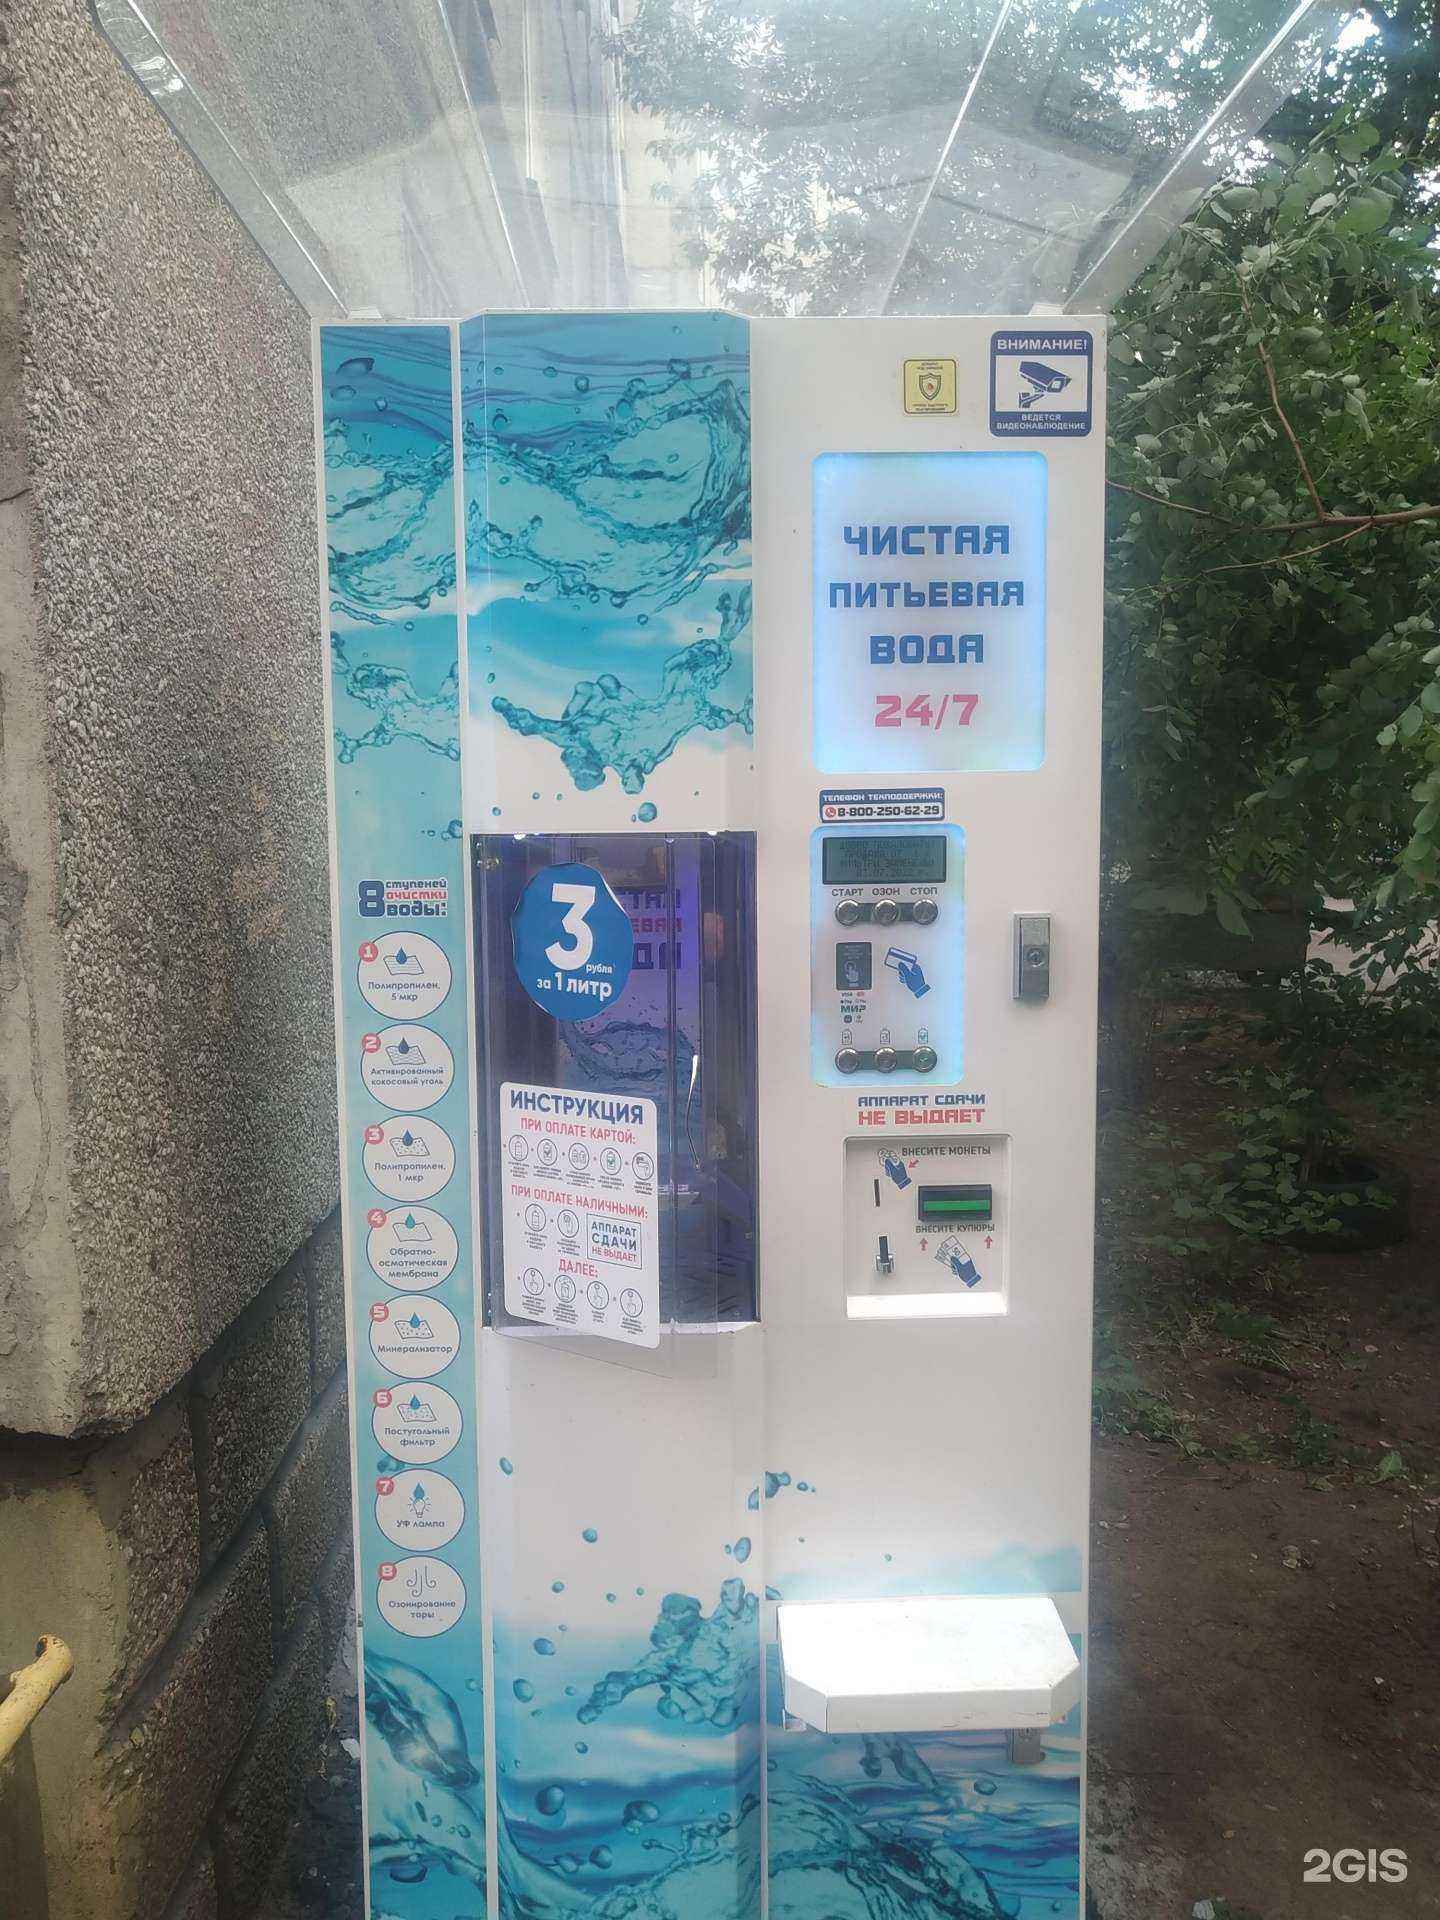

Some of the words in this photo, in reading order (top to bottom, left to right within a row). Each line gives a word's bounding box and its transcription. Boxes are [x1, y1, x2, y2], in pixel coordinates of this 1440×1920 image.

[997, 339, 1087, 350] ВНИМАНИЕ!
[1021, 413, 1062, 421] ВЕДЕТСЯ
[996, 422, 1086, 430] ВИДЕОНАБЛЮДЕНИЕ
[843, 525, 1010, 556] ЧИСТАЯ
[828, 580, 1025, 610] ПИТЬЕВАЯ
[870, 634, 985, 665] ВОДА
[874, 693, 980, 729] 24/7
[823, 794, 865, 802] ТЕЛЕФОН
[837, 805, 940, 817] 8-800-250-62-29
[386, 879, 447, 890] ступеней
[386, 890, 447, 900] очистки
[831, 888, 864, 896] СТАРТ
[872, 887, 900, 896] ОЗОН
[910, 887, 938, 895] СТОП
[359, 880, 385, 917] 8
[386, 900, 447, 916] воды:
[544, 883, 596, 971] 3
[364, 945, 373, 958] 1
[586, 963, 613, 974] рубля
[536, 978, 552, 990] за
[555, 972, 563, 991] 1
[566, 978, 613, 1002] литр
[399, 994, 418, 1002] мкр
[365, 1036, 377, 1046] 2
[370, 1067, 444, 1078] Активированный
[371, 1078, 418, 1086] кокосовый
[420, 1079, 444, 1087] уголь
[858, 1095, 928, 1107] АППАРАТ
[935, 1094, 986, 1106] СДАЧИ
[510, 1089, 644, 1125] ИНСТРУКЦИЯ
[858, 1111, 886, 1125] НЕ
[894, 1109, 986, 1125] ВЫДАЕТ
[368, 1130, 380, 1141] 3
[520, 1117, 542, 1132] ПРИ
[546, 1121, 587, 1138] ОПЛАТЕ
[590, 1127, 637, 1145] КАРТОЙ:
[902, 1147, 946, 1157] ВНЕСИТЕ
[948, 1146, 991, 1156] МОНЕТЫ
[405, 1174, 424, 1183] мкр
[511, 1184, 531, 1200] ПРИ
[534, 1189, 573, 1206] ОПЛАТЕ
[576, 1194, 649, 1219] НАЛИЧНЫМИ:
[592, 1221, 637, 1238] АППАРАТ
[915, 1224, 954, 1234] ВНЕСИТЕ
[957, 1223, 995, 1233] КУПЮРЫ
[592, 1233, 637, 1252] СДАЧИ
[592, 1246, 602, 1256] НЕ
[603, 1247, 637, 1262] ВЫДАЕТ
[558, 1258, 599, 1278] ДАЛЕЕ:
[388, 1269, 439, 1279] мембрана
[372, 1306, 385, 1319] 5
[377, 1345, 453, 1355] Минерализатор
[384, 1427, 450, 1437] Постугольный
[400, 1439, 436, 1448] фильтр
[379, 1481, 390, 1493] 7
[396, 1520, 410, 1528] УФ
[413, 1521, 445, 1529] лампа
[382, 1565, 393, 1577] 8
[388, 1600, 456, 1609] Озонирование
